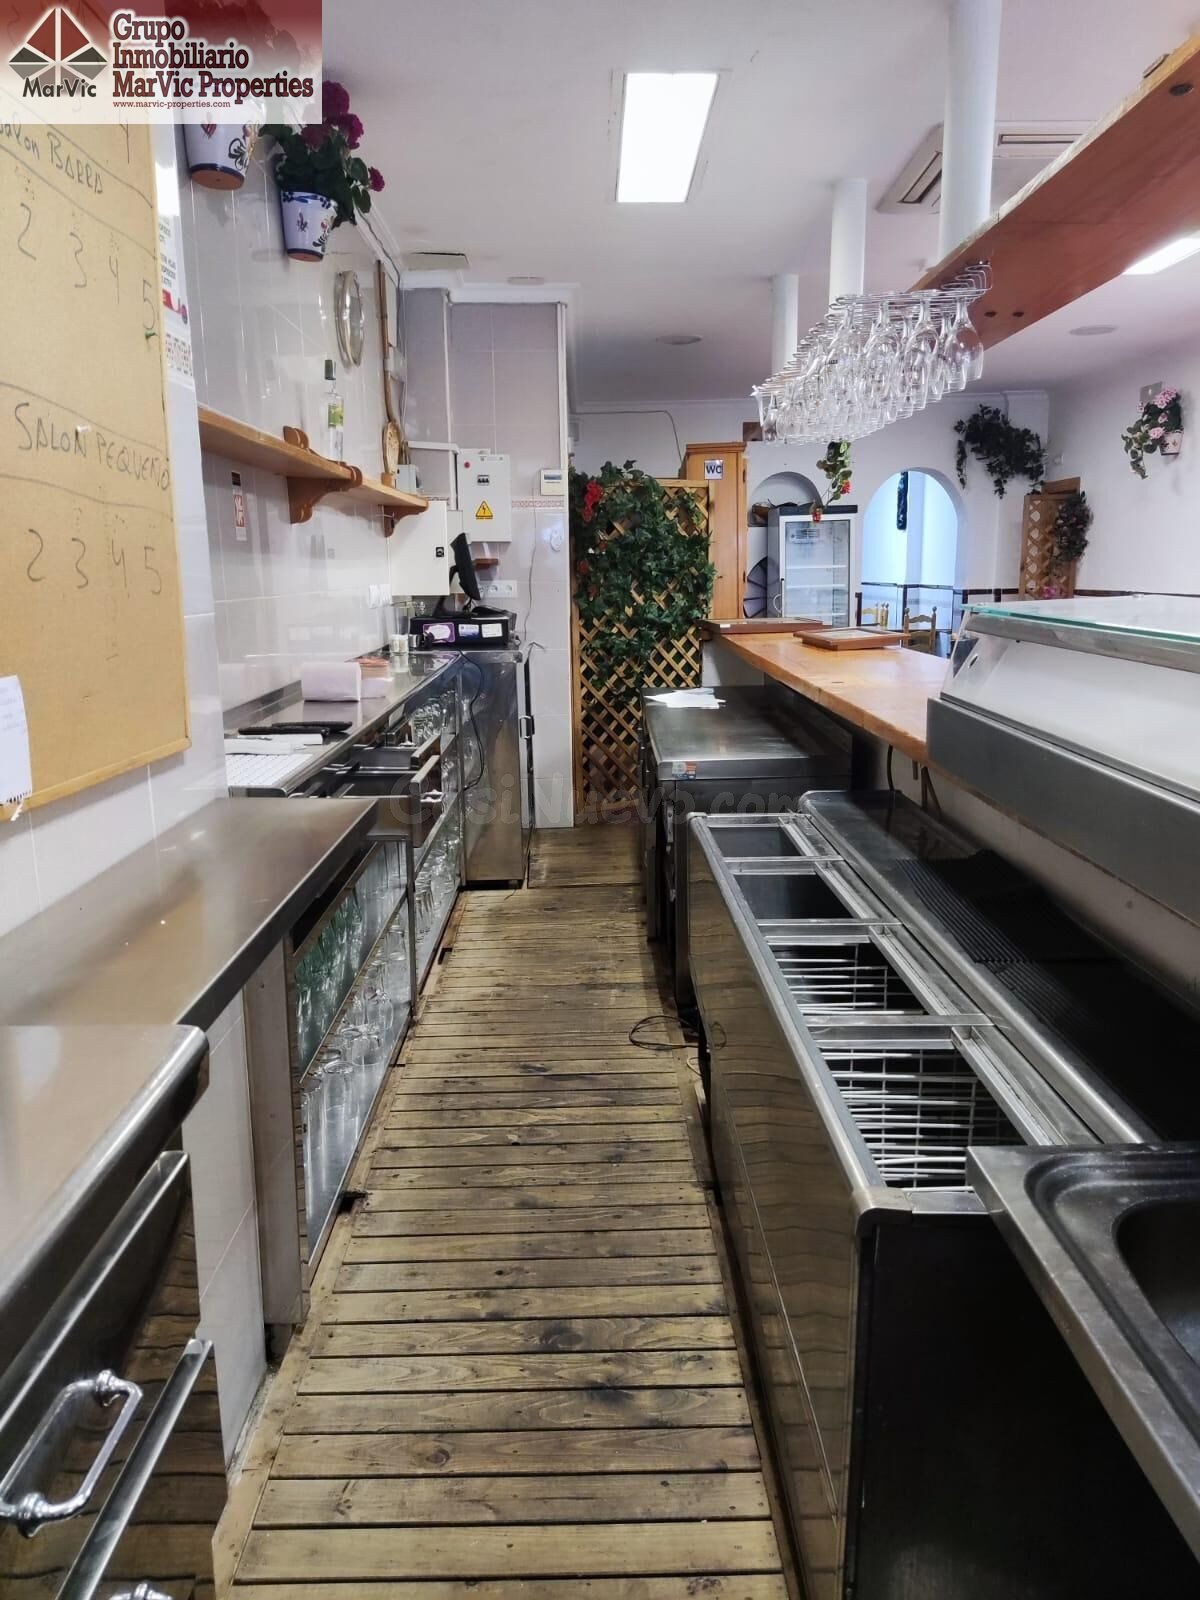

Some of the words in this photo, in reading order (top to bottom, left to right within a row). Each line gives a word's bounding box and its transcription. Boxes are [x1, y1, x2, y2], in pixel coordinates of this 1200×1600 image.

[18, 203, 36, 260] 2
[70, 232, 87, 288] 3
[109, 255, 120, 304] 4
[143, 279, 155, 330] 5
[15, 402, 87, 458] SALON
[706, 465, 722, 474] WC
[27, 529, 46, 582] 2
[72, 538, 89, 589] 3
[112, 538, 127, 589] 4
[144, 547, 162, 594] 5
